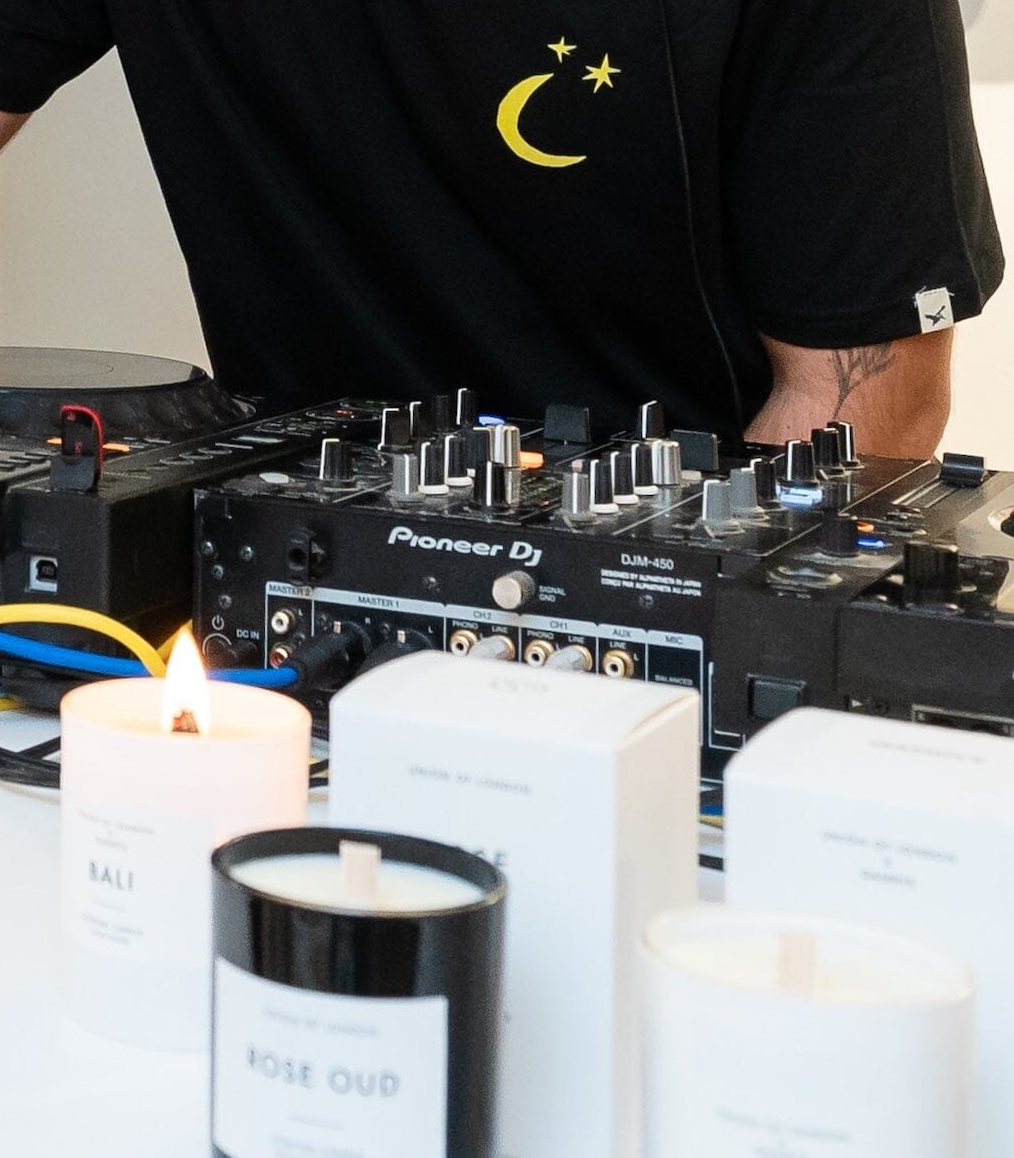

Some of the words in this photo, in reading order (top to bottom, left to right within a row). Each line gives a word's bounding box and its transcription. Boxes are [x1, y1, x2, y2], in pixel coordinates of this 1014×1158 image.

[387, 526, 504, 557] Pioneer
[620, 553, 675, 570] DJM-450
[269, 584, 303, 595] MASTER
[358, 595, 393, 608] MASTER
[452, 620, 479, 630] PHONO
[491, 625, 508, 634] LINE
[236, 629, 249, 639] DC
[250, 631, 260, 640] IN
[527, 630, 554, 640] PHONO
[612, 628, 632, 638] AUX
[568, 634, 585, 644] LINE
[665, 635, 684, 645] MIC
[609, 640, 627, 650] LINE
[654, 673, 694, 687] BALANCED
[88, 858, 134, 892] BALI
[328, 1066, 400, 1098] OUD
